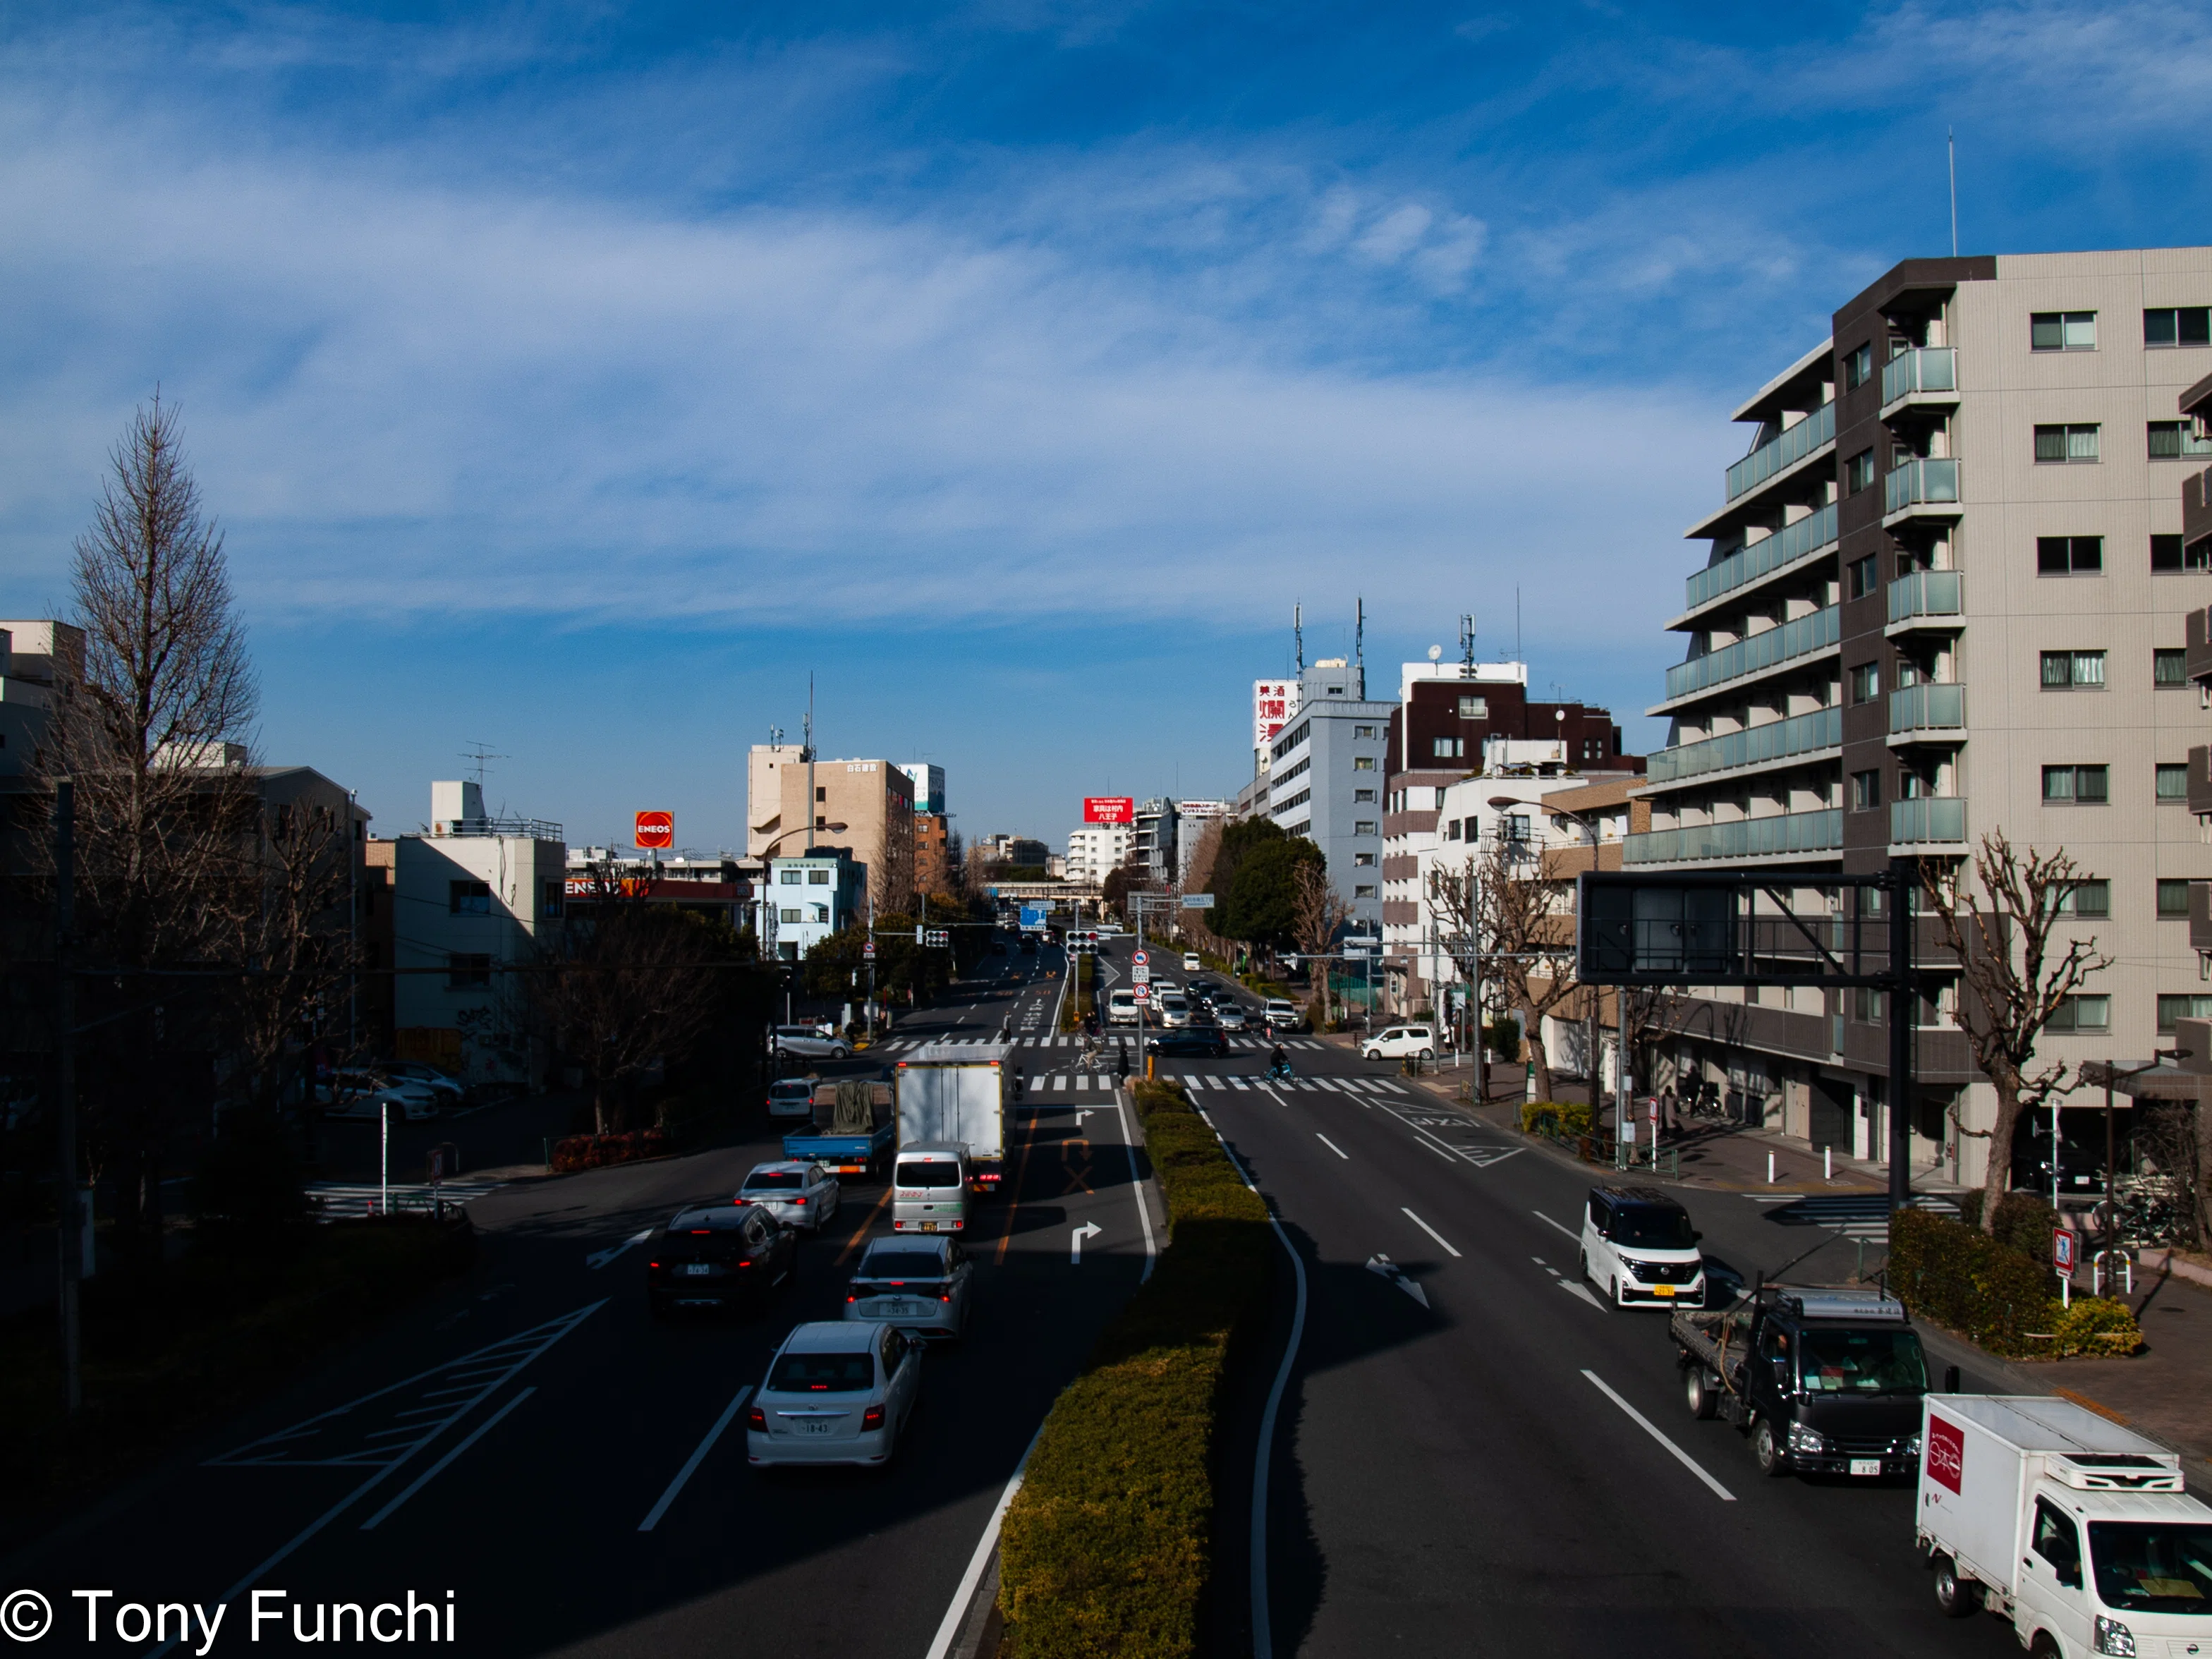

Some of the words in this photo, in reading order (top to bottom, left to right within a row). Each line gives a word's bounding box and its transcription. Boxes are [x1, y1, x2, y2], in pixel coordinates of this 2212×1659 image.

[1259, 685, 1285, 697] 美酒
[846, 763, 878, 773] 白石建設
[637, 825, 671, 834] ENEOS
